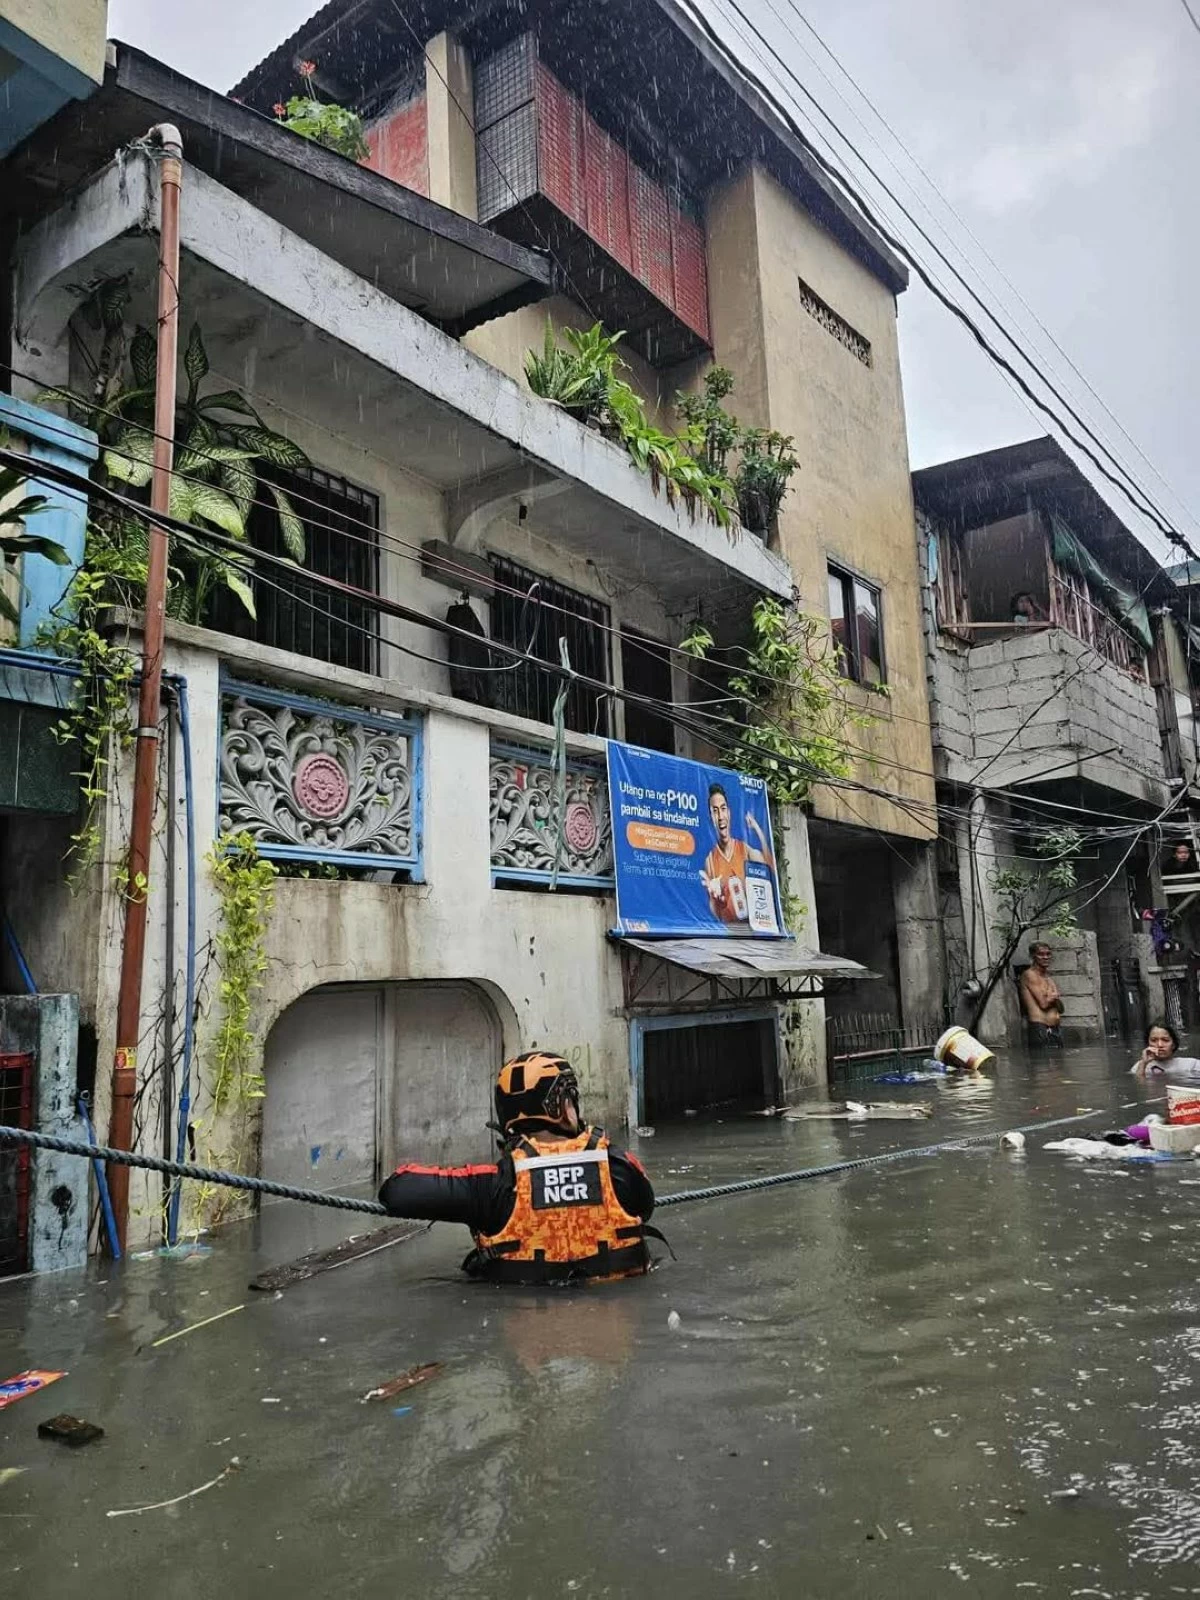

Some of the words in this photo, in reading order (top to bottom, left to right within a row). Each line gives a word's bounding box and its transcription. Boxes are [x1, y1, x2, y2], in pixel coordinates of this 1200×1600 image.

[645, 789, 656, 799] na
[656, 791, 667, 804] ng
[620, 804, 651, 816] pambili
[652, 810, 662, 820] sa
[663, 809, 700, 827] tindahan!
[642, 867, 655, 876] and
[543, 1166, 585, 1186] BFP
[543, 1183, 589, 1204] NCR
